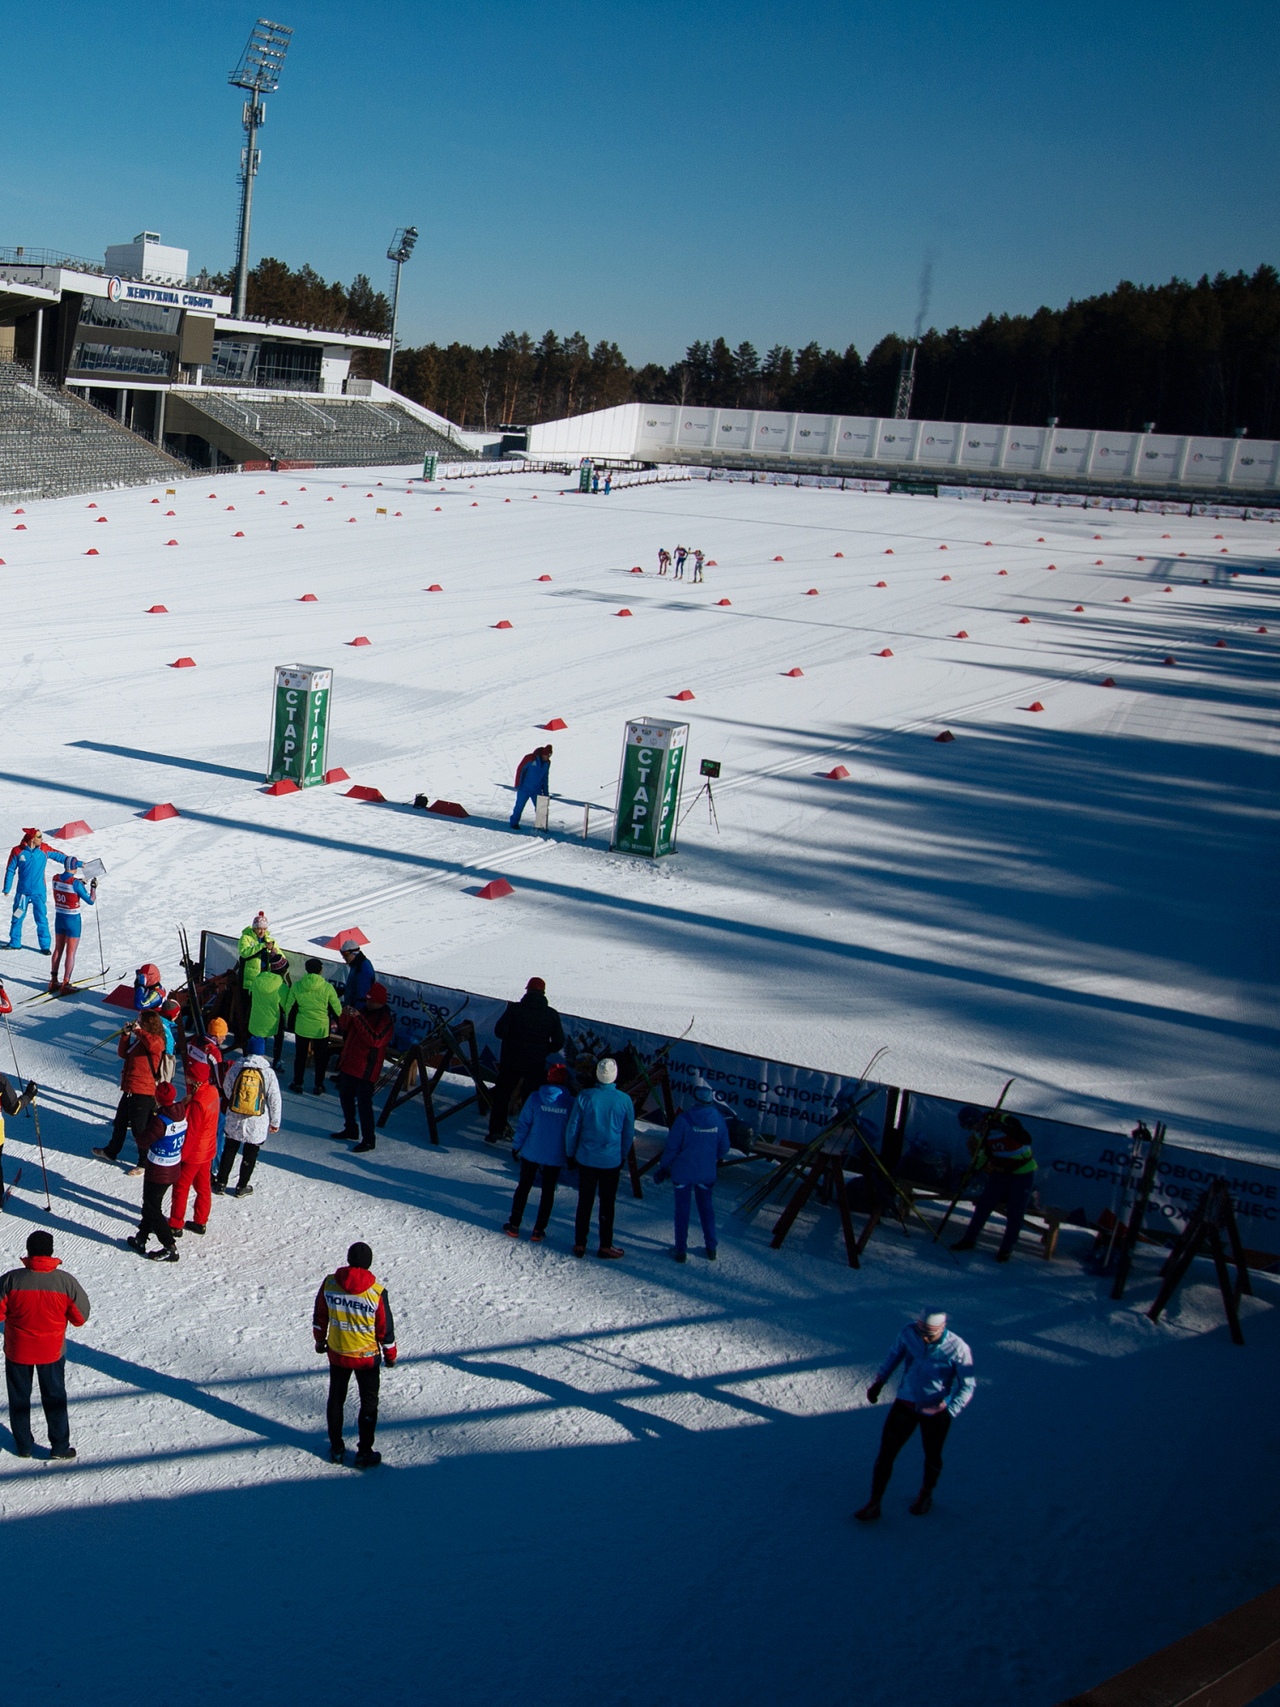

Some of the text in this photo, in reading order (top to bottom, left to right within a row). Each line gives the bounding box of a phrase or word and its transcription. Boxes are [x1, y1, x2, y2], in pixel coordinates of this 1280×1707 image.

[126, 286, 214, 309] ЖЕМЧУЖИНА СИБИРИ
[283, 690, 299, 772] СТАРТ
[310, 691, 323, 774] СТАРТ
[630, 748, 653, 840] СТАРТ
[659, 749, 679, 841] СТАРТ
[56, 893, 66, 903] 30
[325, 1294, 375, 1314] ТЮМЕНЬ
